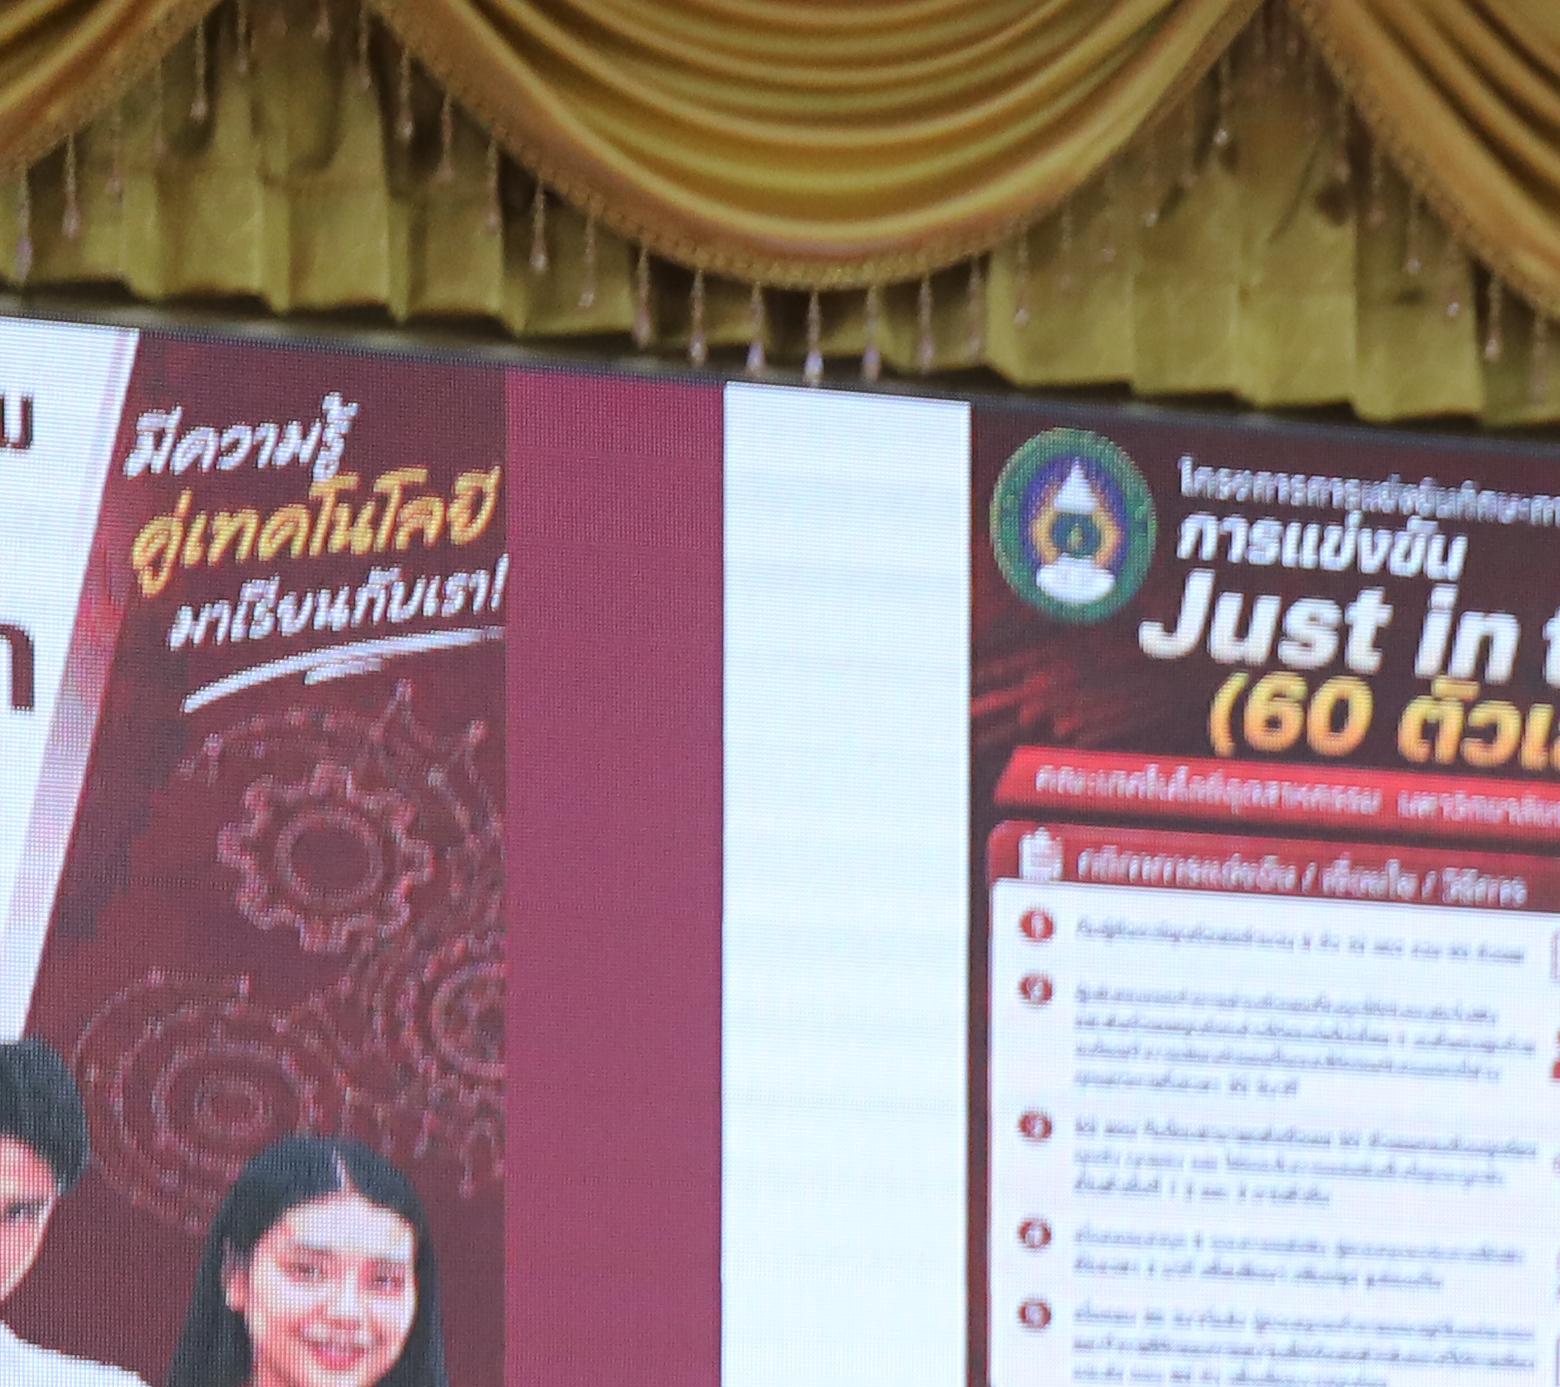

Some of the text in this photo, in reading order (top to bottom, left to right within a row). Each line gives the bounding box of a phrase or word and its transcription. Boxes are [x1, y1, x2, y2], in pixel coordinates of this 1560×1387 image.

[123, 389, 360, 482] มีความรู้
[130, 465, 502, 600] คู่เทคโนโลยี
[1176, 509, 1469, 582] การแข่งขัน
[1138, 567, 1394, 676] Just
[1414, 583, 1522, 685] in
[1208, 670, 1374, 758] (60
